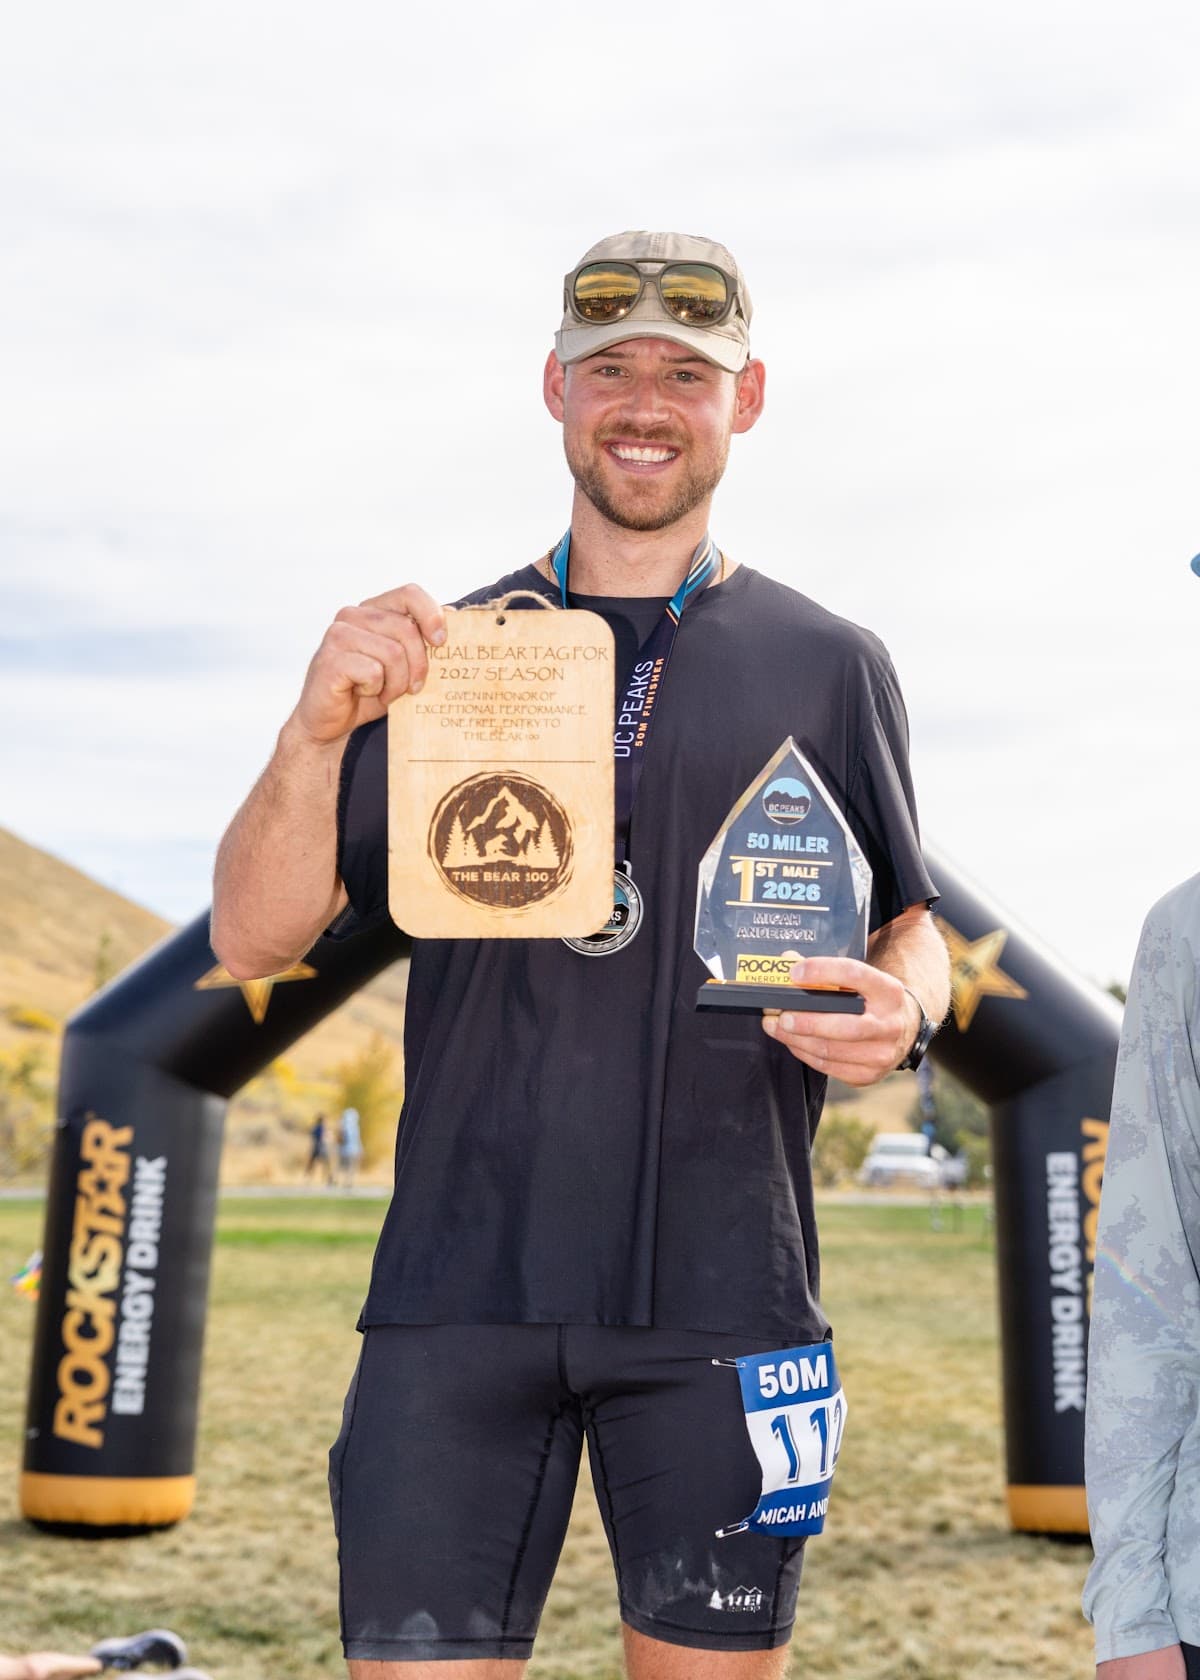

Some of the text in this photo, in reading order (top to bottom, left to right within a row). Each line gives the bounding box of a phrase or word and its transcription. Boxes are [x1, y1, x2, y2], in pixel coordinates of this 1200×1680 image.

[477, 645, 528, 660] BEAR
[530, 645, 570, 660] TAG
[573, 646, 609, 660] FOR
[440, 666, 564, 681] 2027 SEASON
[445, 690, 557, 701] GIVEN IN HONOR OF
[618, 660, 654, 726] PEAKS
[415, 704, 587, 716] EXCEPTIONAL PERFORMANCE
[634, 658, 665, 748] 50M FINISHER
[502, 718, 541, 729] ENTRY
[542, 718, 561, 729] TO
[746, 832, 829, 853] 50 MILER
[452, 871, 549, 883] THE BEAR 100
[782, 865, 820, 880] MALE
[762, 881, 821, 902] 2026
[753, 912, 801, 926] MICAH
[736, 927, 817, 941] ANDERSON
[53, 1118, 134, 1449] ROCKSTAR
[112, 1155, 168, 1415] ENERGY DRINK
[1046, 1152, 1086, 1413] ENERGY DRINK
[758, 1354, 829, 1399] 50M
[757, 1503, 806, 1525] MICAH
